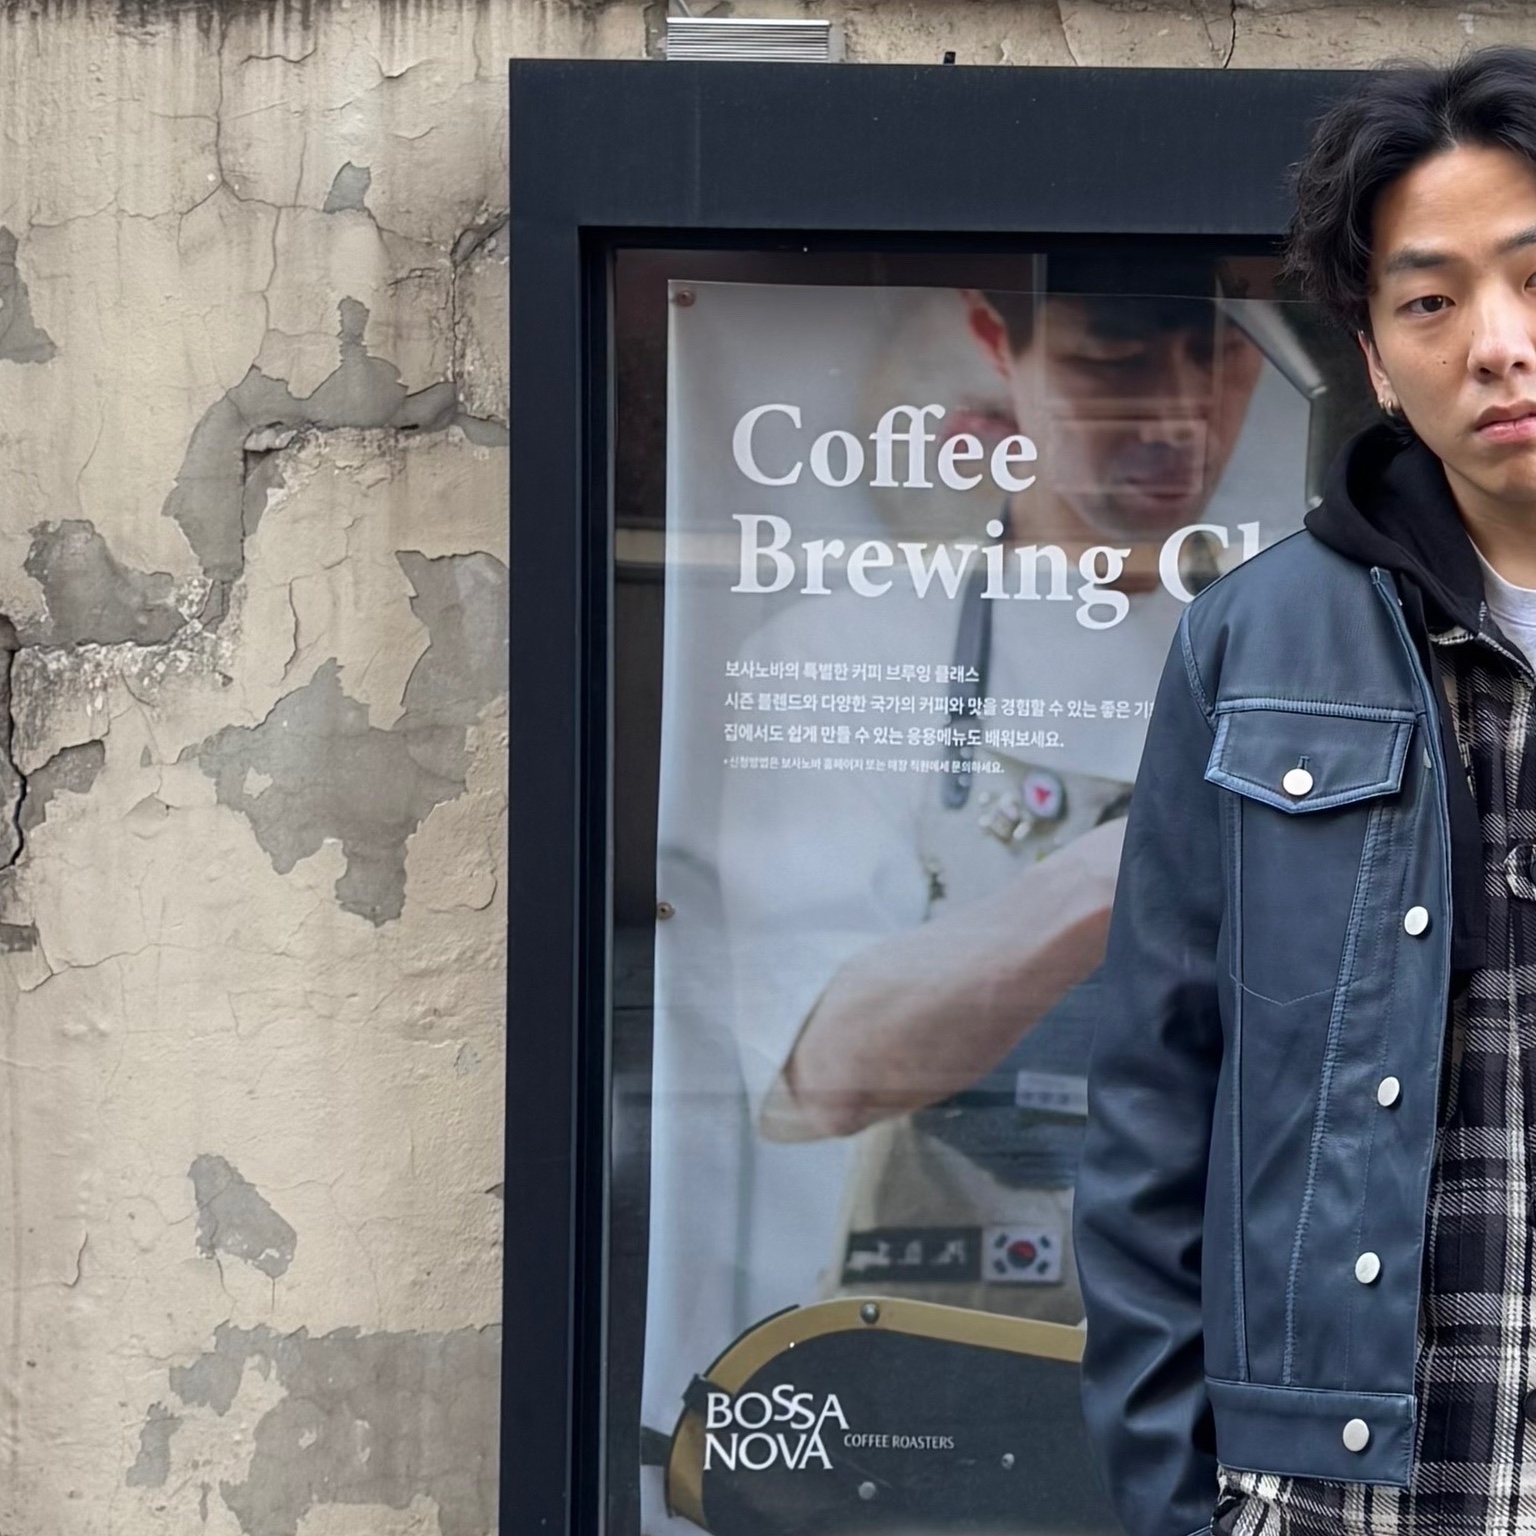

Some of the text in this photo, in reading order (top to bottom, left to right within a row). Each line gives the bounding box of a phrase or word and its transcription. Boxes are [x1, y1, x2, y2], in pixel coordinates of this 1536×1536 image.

[732, 403, 1038, 493] Coffee
[730, 513, 1131, 630] Brewing
[725, 660, 980, 684] 보사노바의 특별한 커피 브루잉 클래스
[725, 691, 754, 711] 시즌
[758, 692, 818, 712] 블렌드와
[821, 694, 867, 713] 다양한
[870, 695, 915, 714] 국가의
[919, 696, 964, 715] 커피와
[967, 697, 997, 717] 맛을
[1001, 698, 1046, 718] 경험할
[1048, 700, 1063, 717] 수
[1067, 700, 1097, 718] 있는
[1100, 700, 1131, 719] 좋은
[724, 722, 1065, 749] 집에서도 쉽게 만들 수 있는 응용메뉴도 배워보세요.
[705, 1383, 850, 1431] BOSSA
[703, 1429, 834, 1472] NOVA
[843, 1433, 955, 1450] COFFEE ROASTERS
